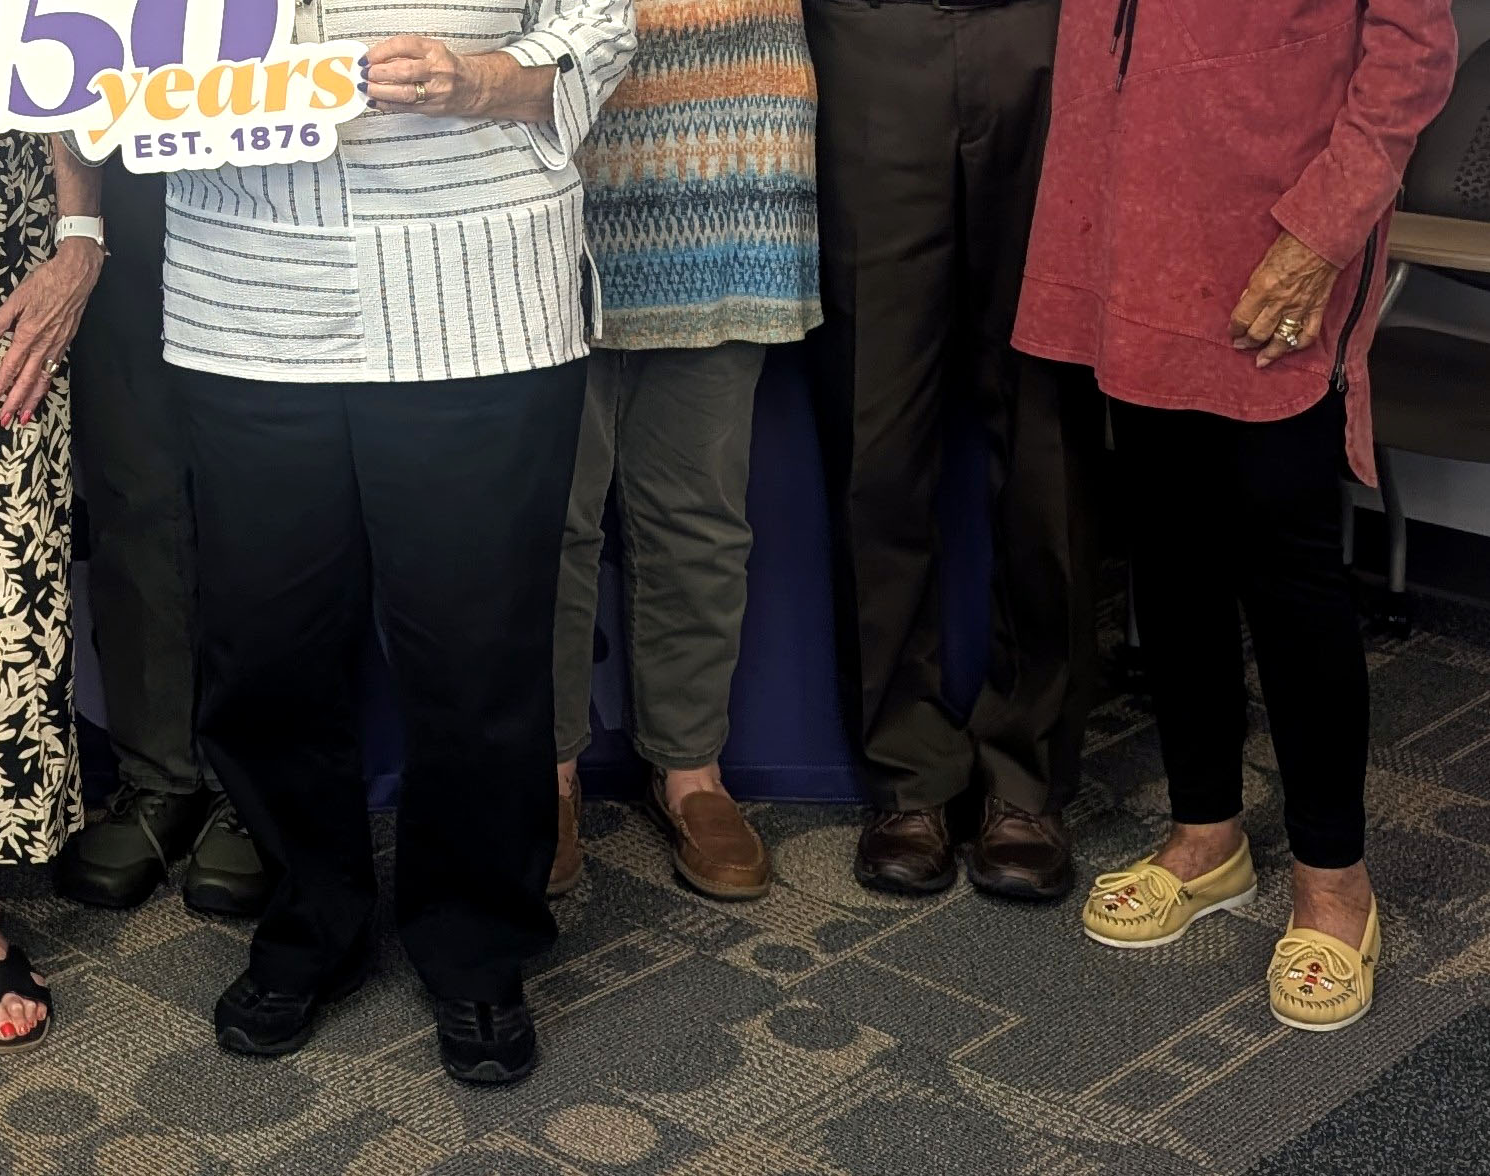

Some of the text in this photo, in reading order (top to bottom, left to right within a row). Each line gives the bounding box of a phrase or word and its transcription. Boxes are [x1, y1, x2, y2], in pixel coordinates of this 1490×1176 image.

[89, 55, 356, 145] years
[134, 122, 321, 159] EST. 1876
